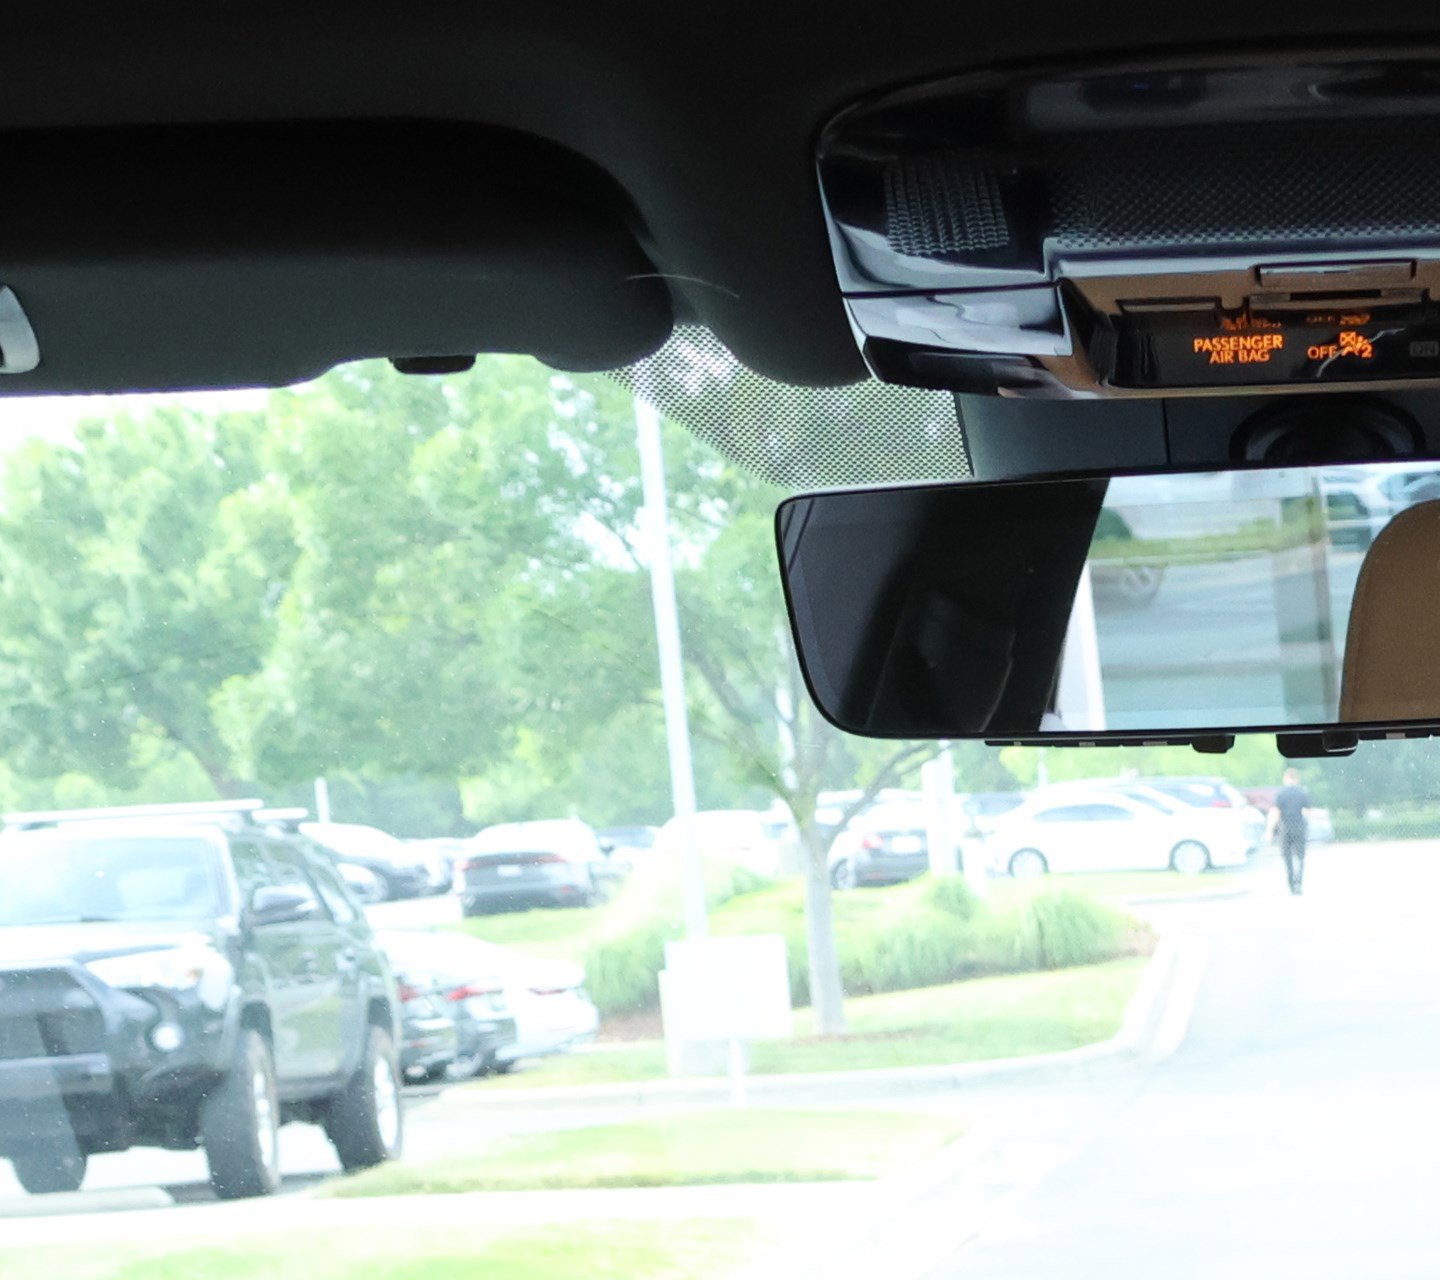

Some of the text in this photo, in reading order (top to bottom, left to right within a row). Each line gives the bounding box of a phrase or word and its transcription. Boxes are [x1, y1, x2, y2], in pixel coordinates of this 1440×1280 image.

[1193, 334, 1282, 352] PASSENGER
[1210, 349, 1269, 363] AIR BAG
